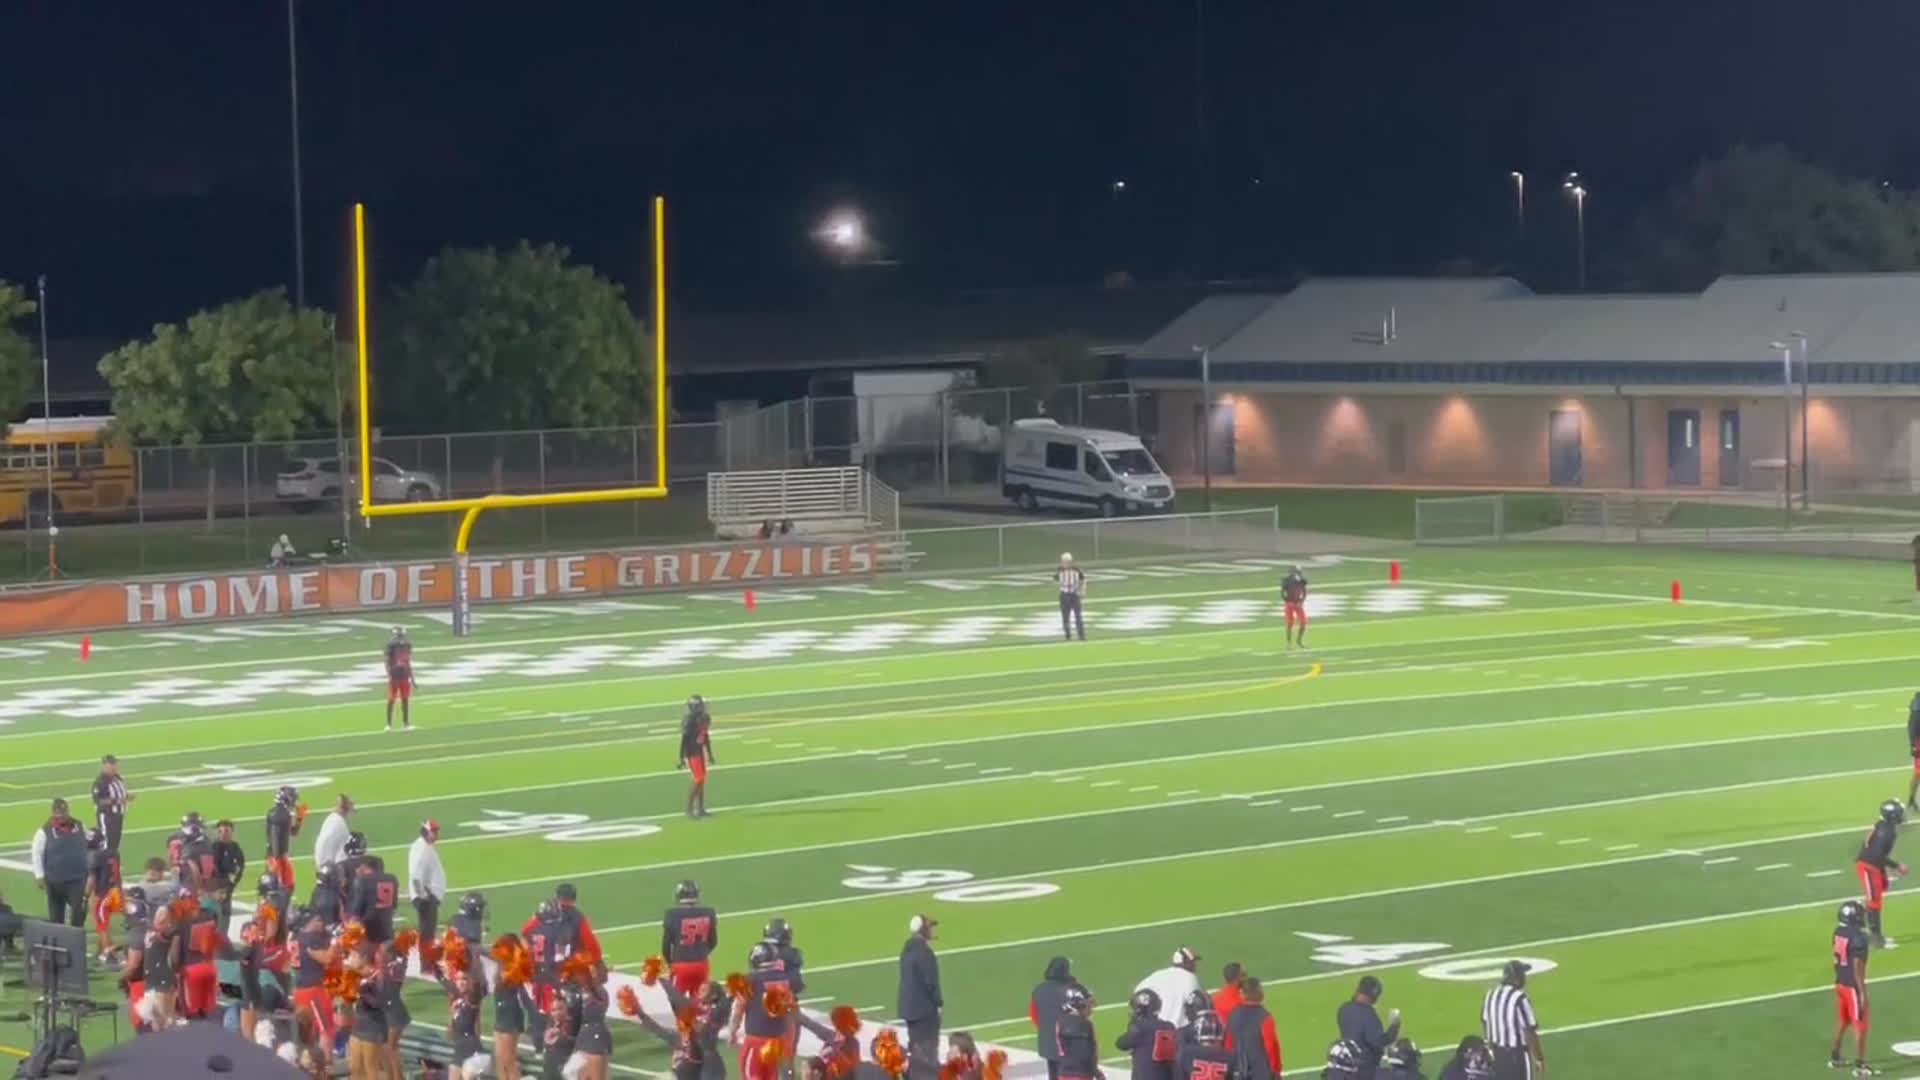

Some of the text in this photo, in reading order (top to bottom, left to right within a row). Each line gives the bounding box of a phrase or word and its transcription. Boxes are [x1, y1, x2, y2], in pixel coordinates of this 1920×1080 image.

[124, 571, 320, 624] HOME
[361, 564, 436, 606] OF
[472, 555, 585, 600] THE
[616, 543, 873, 587] GRIZZLIES
[1309, 941, 1558, 981] 40
